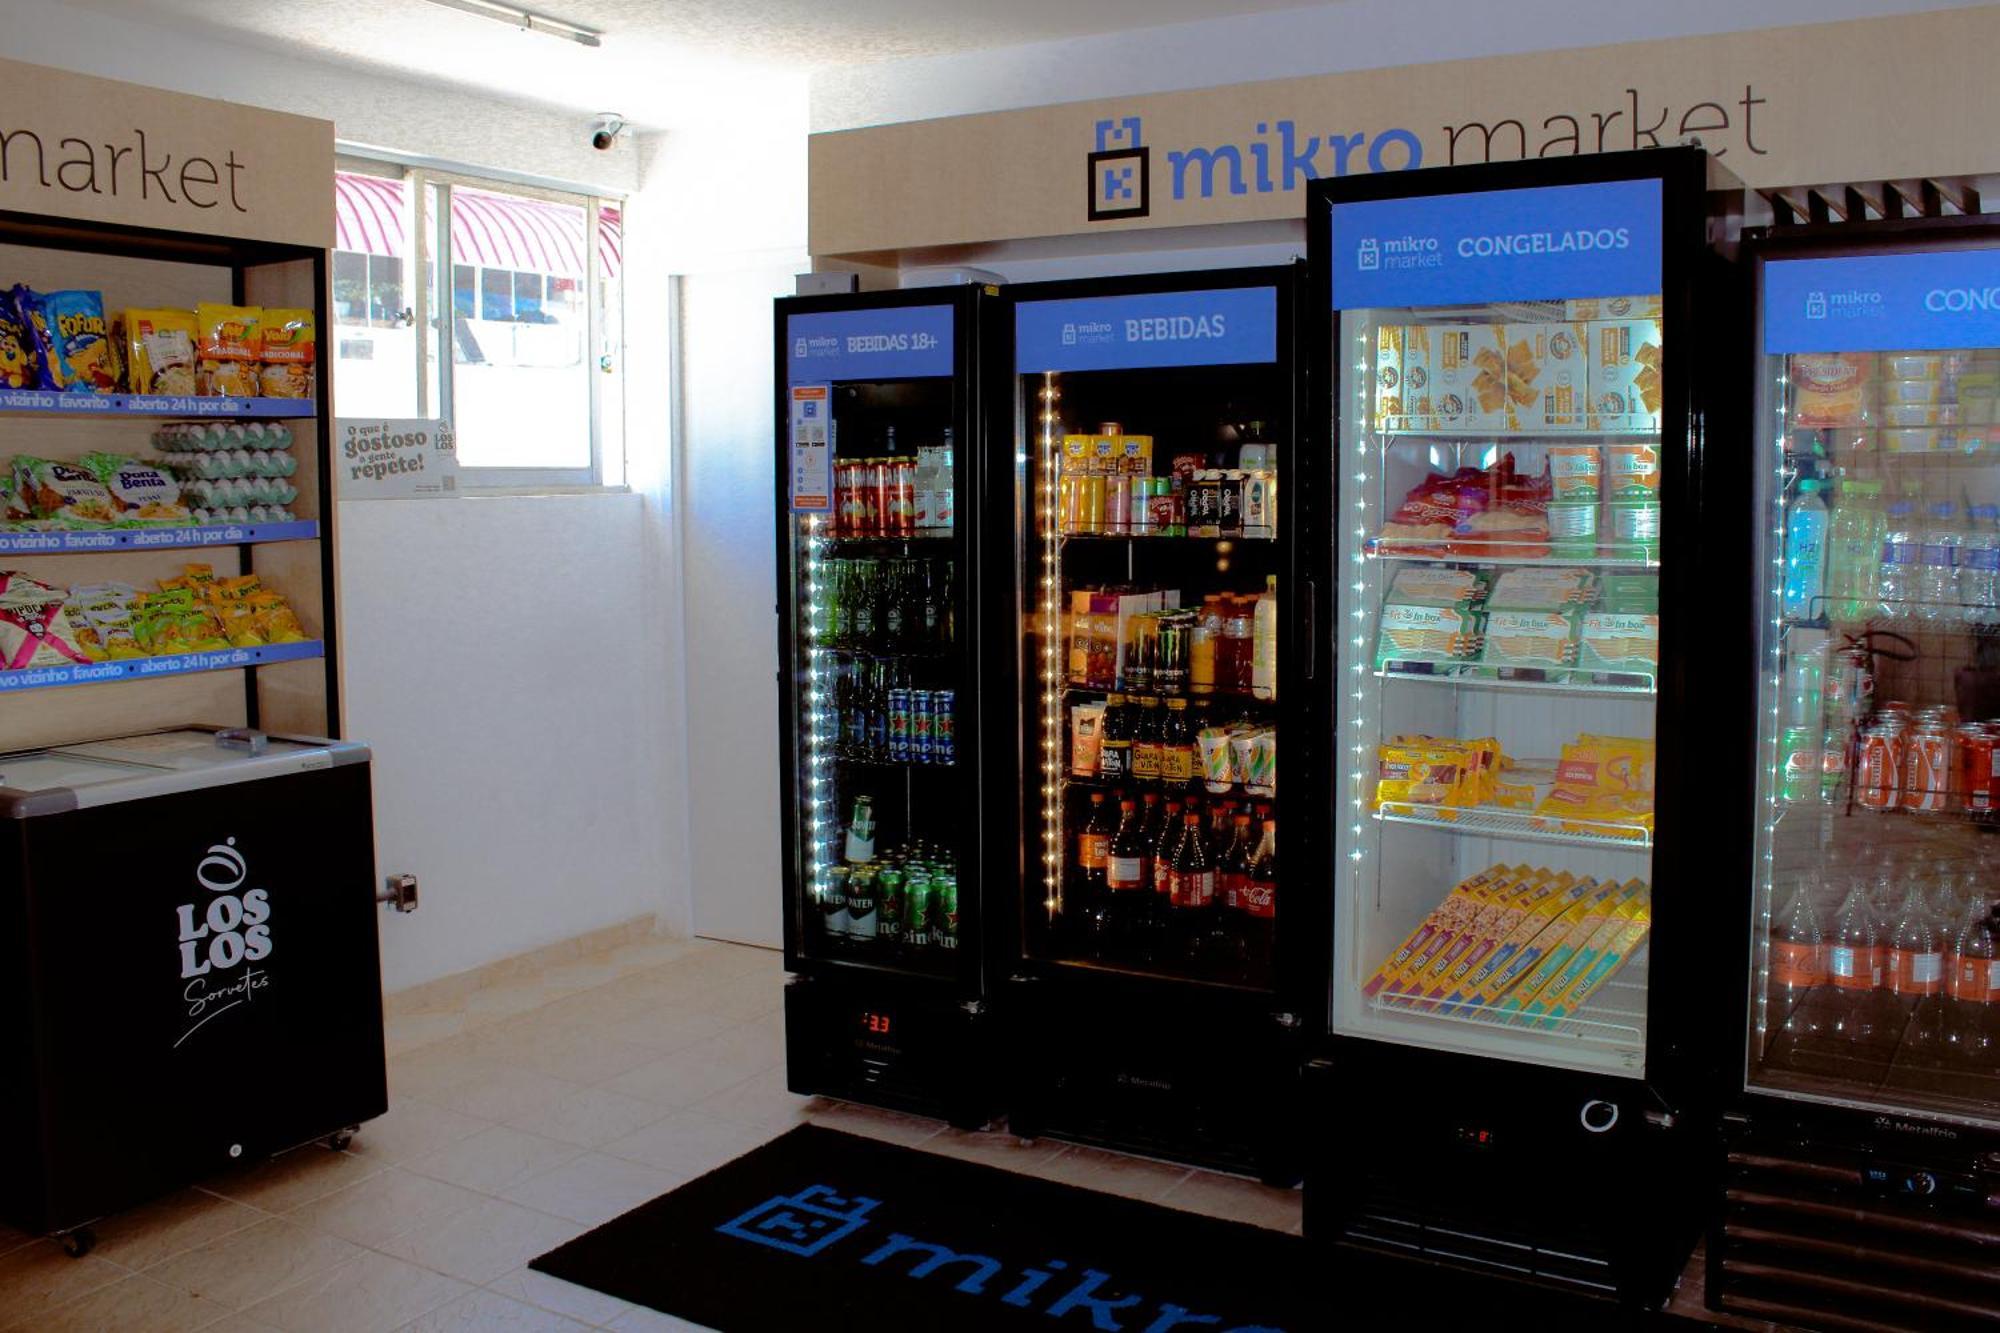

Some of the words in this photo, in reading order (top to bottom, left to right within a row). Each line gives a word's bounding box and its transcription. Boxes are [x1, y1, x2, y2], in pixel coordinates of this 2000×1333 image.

[1168, 121, 1424, 200] mikro
[1443, 85, 1767, 166] market
[1384, 236, 1438, 253] mikro
[1457, 228, 1630, 258] CONGELADOS
[1384, 253, 1443, 269] market
[1831, 291, 1882, 304] mikro
[1079, 322, 1112, 334] mikro
[1126, 314, 1225, 342] BEBIDAS
[808, 336, 838, 347] mikro
[847, 334, 909, 353] BEBIDAS
[911, 333, 939, 351] 18+
[4, 391, 54, 408] vizinho
[59, 394, 111, 409] favorito
[129, 398, 169, 411] aberto
[347, 425, 357, 435] O
[360, 425, 380, 437] que
[344, 432, 427, 459] gostoso
[351, 453, 425, 480] repete!
[369, 451, 396, 463] gente
[119, 471, 160, 480] Dona
[120, 478, 166, 490] Benta
[12, 534, 60, 549] vizinho
[65, 532, 116, 547] favorito
[133, 531, 173, 545] aberto
[203, 531, 223, 544] por
[225, 526, 242, 540] dia
[20, 668, 69, 686] vizinho
[73, 664, 123, 682] favorito
[140, 658, 181, 673] aberto
[210, 655, 230, 669] por
[231, 650, 249, 663] dia
[176, 888, 270, 942] LOS
[179, 924, 273, 978] LOS
[184, 967, 269, 1016] Sorvetes
[1896, 1121, 1958, 1140] Metalfrio
